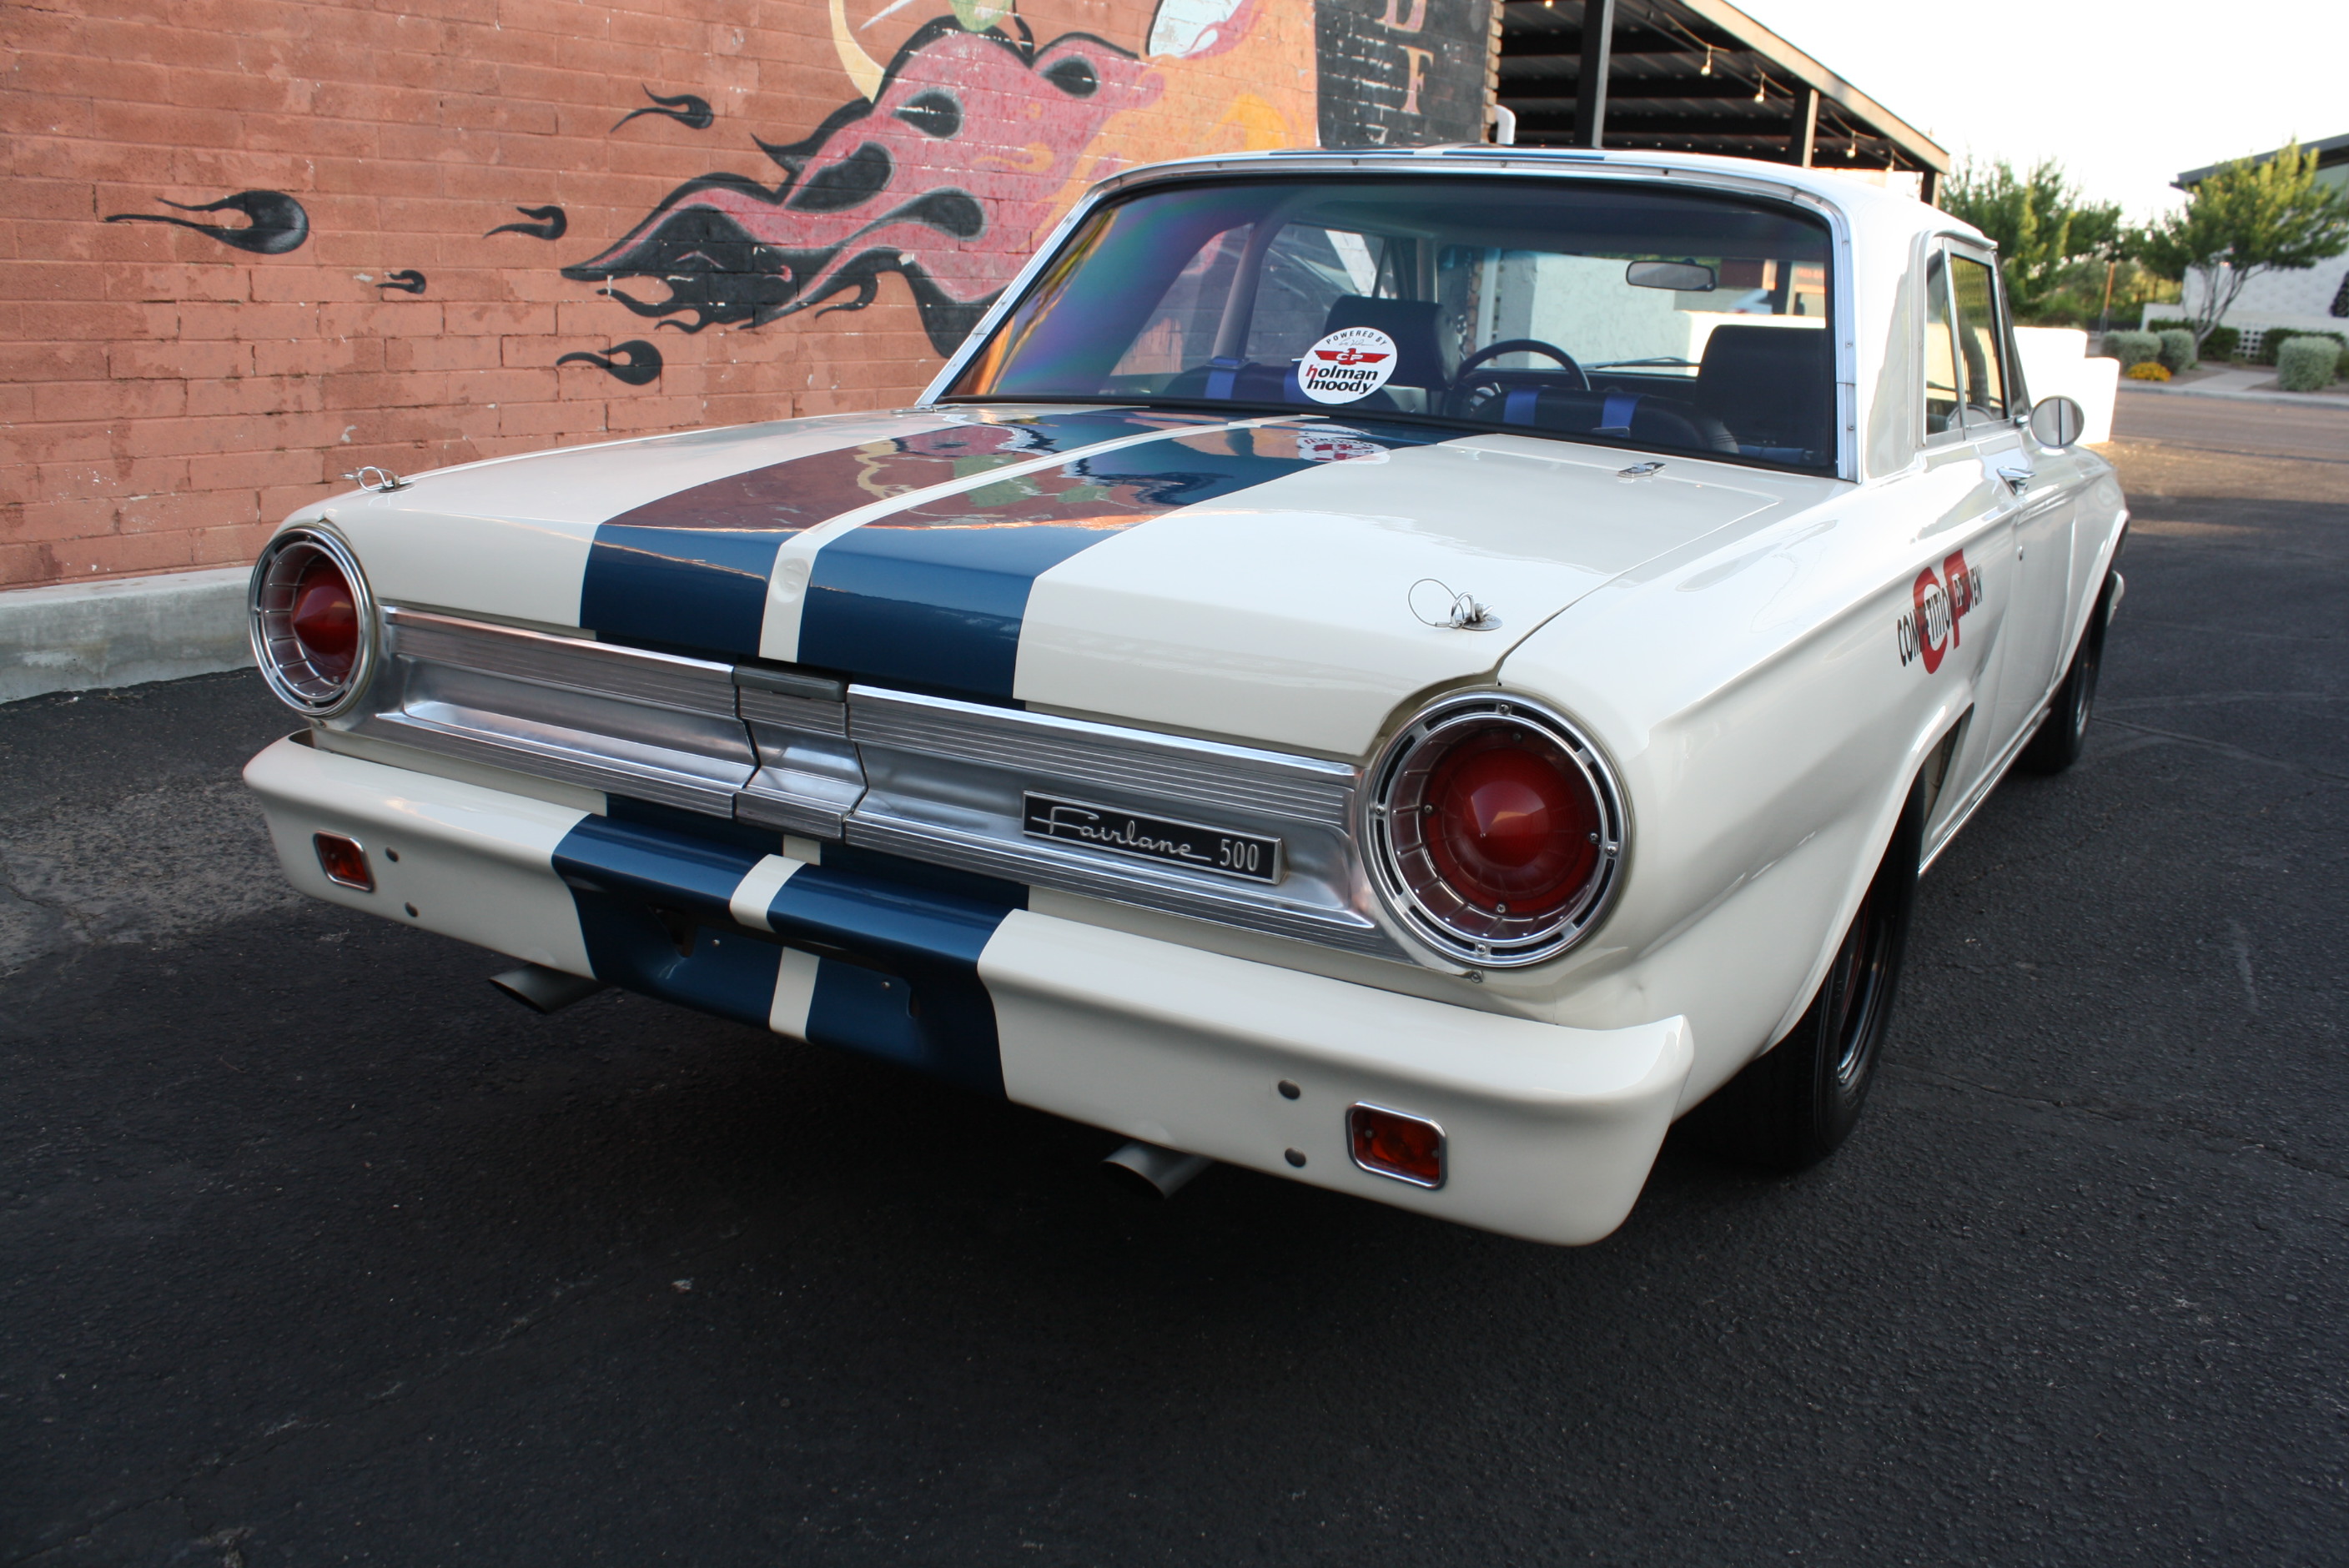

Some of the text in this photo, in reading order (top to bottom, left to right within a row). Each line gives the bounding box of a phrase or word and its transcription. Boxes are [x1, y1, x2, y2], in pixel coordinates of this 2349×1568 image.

[1326, 330, 1373, 344] POWERED
[1376, 336, 1387, 346] BY
[1305, 364, 1378, 381] holman
[1306, 379, 1373, 395] moody
[1030, 806, 1260, 872] Fairlane 500
